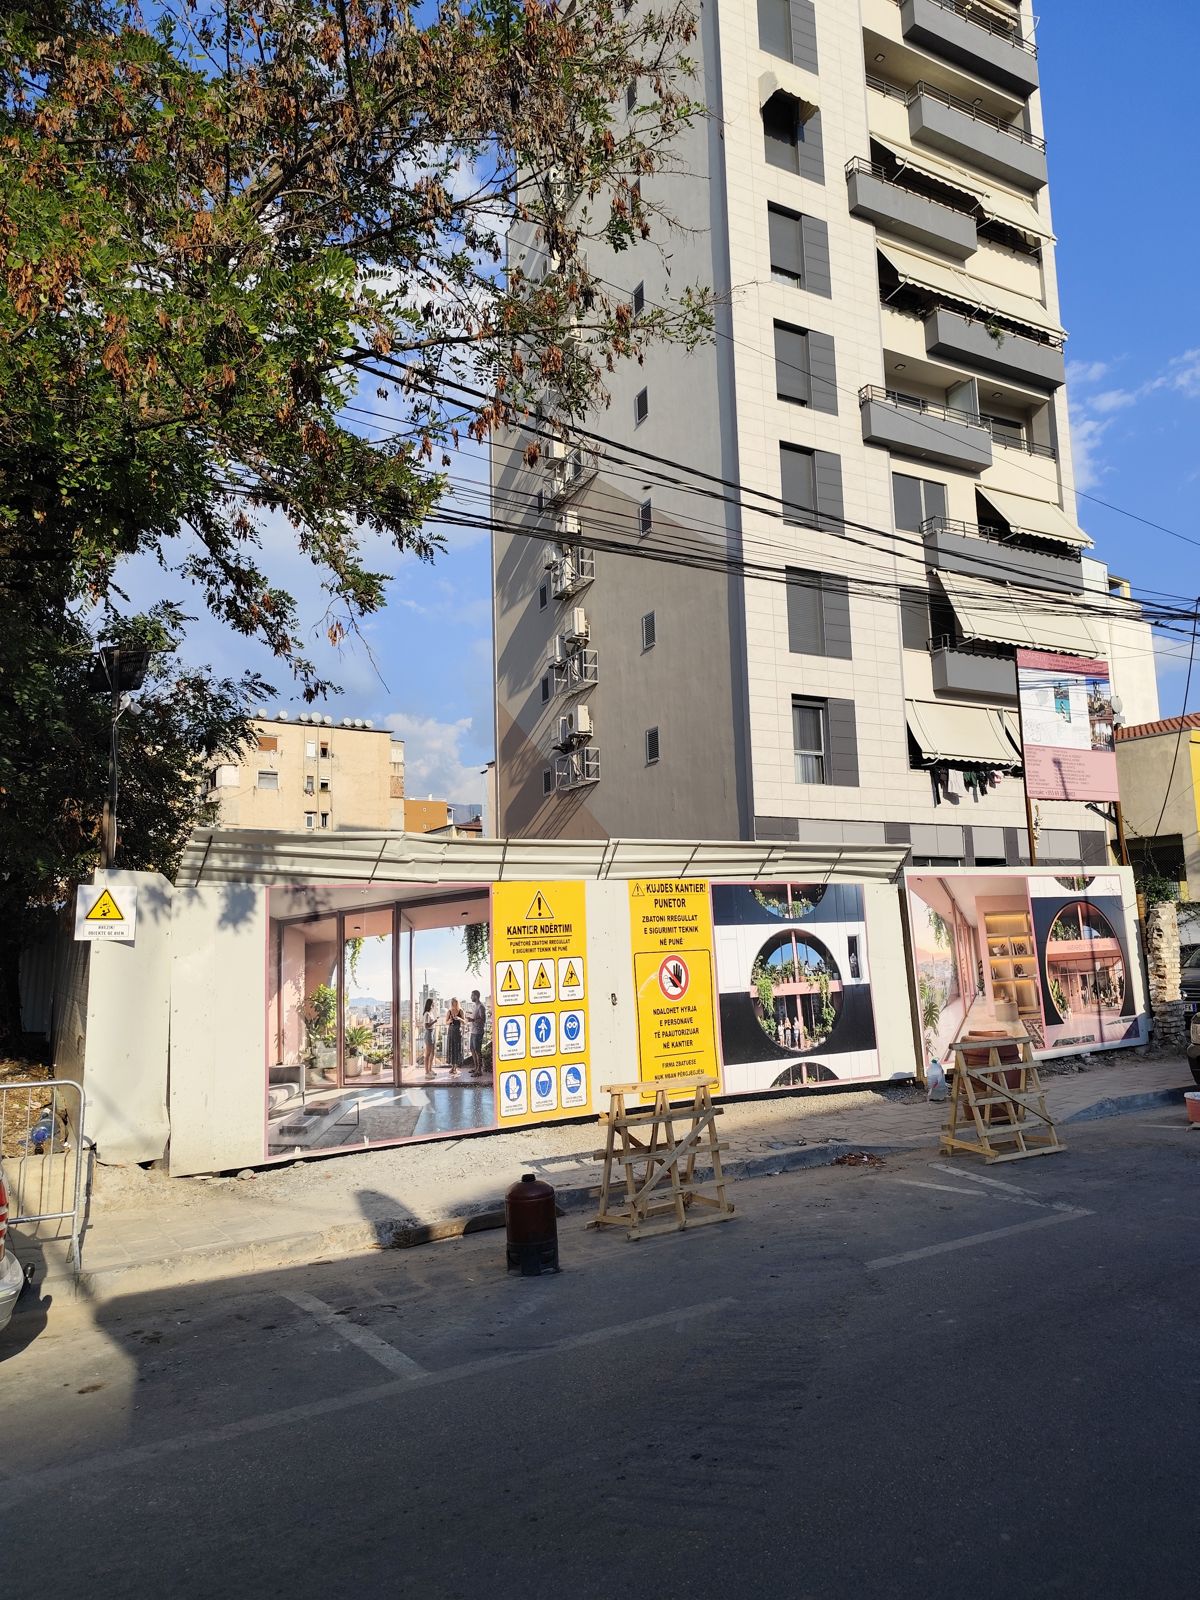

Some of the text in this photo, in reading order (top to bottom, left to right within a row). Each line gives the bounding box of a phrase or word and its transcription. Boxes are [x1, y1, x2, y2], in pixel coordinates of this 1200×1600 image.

[646, 883, 706, 893] KUJDES KANTIER!
[506, 923, 572, 935] KANTIER NDËRTIMI
[649, 926, 677, 934] SIGURIMIT
[653, 1006, 679, 1015] NDALOHET
[664, 1017, 693, 1026] PERSONAVE
[662, 1027, 699, 1038] PAAUTORIZUAR
[671, 1040, 693, 1048] KANTIER
[676, 1059, 696, 1067] ZBATUESE
